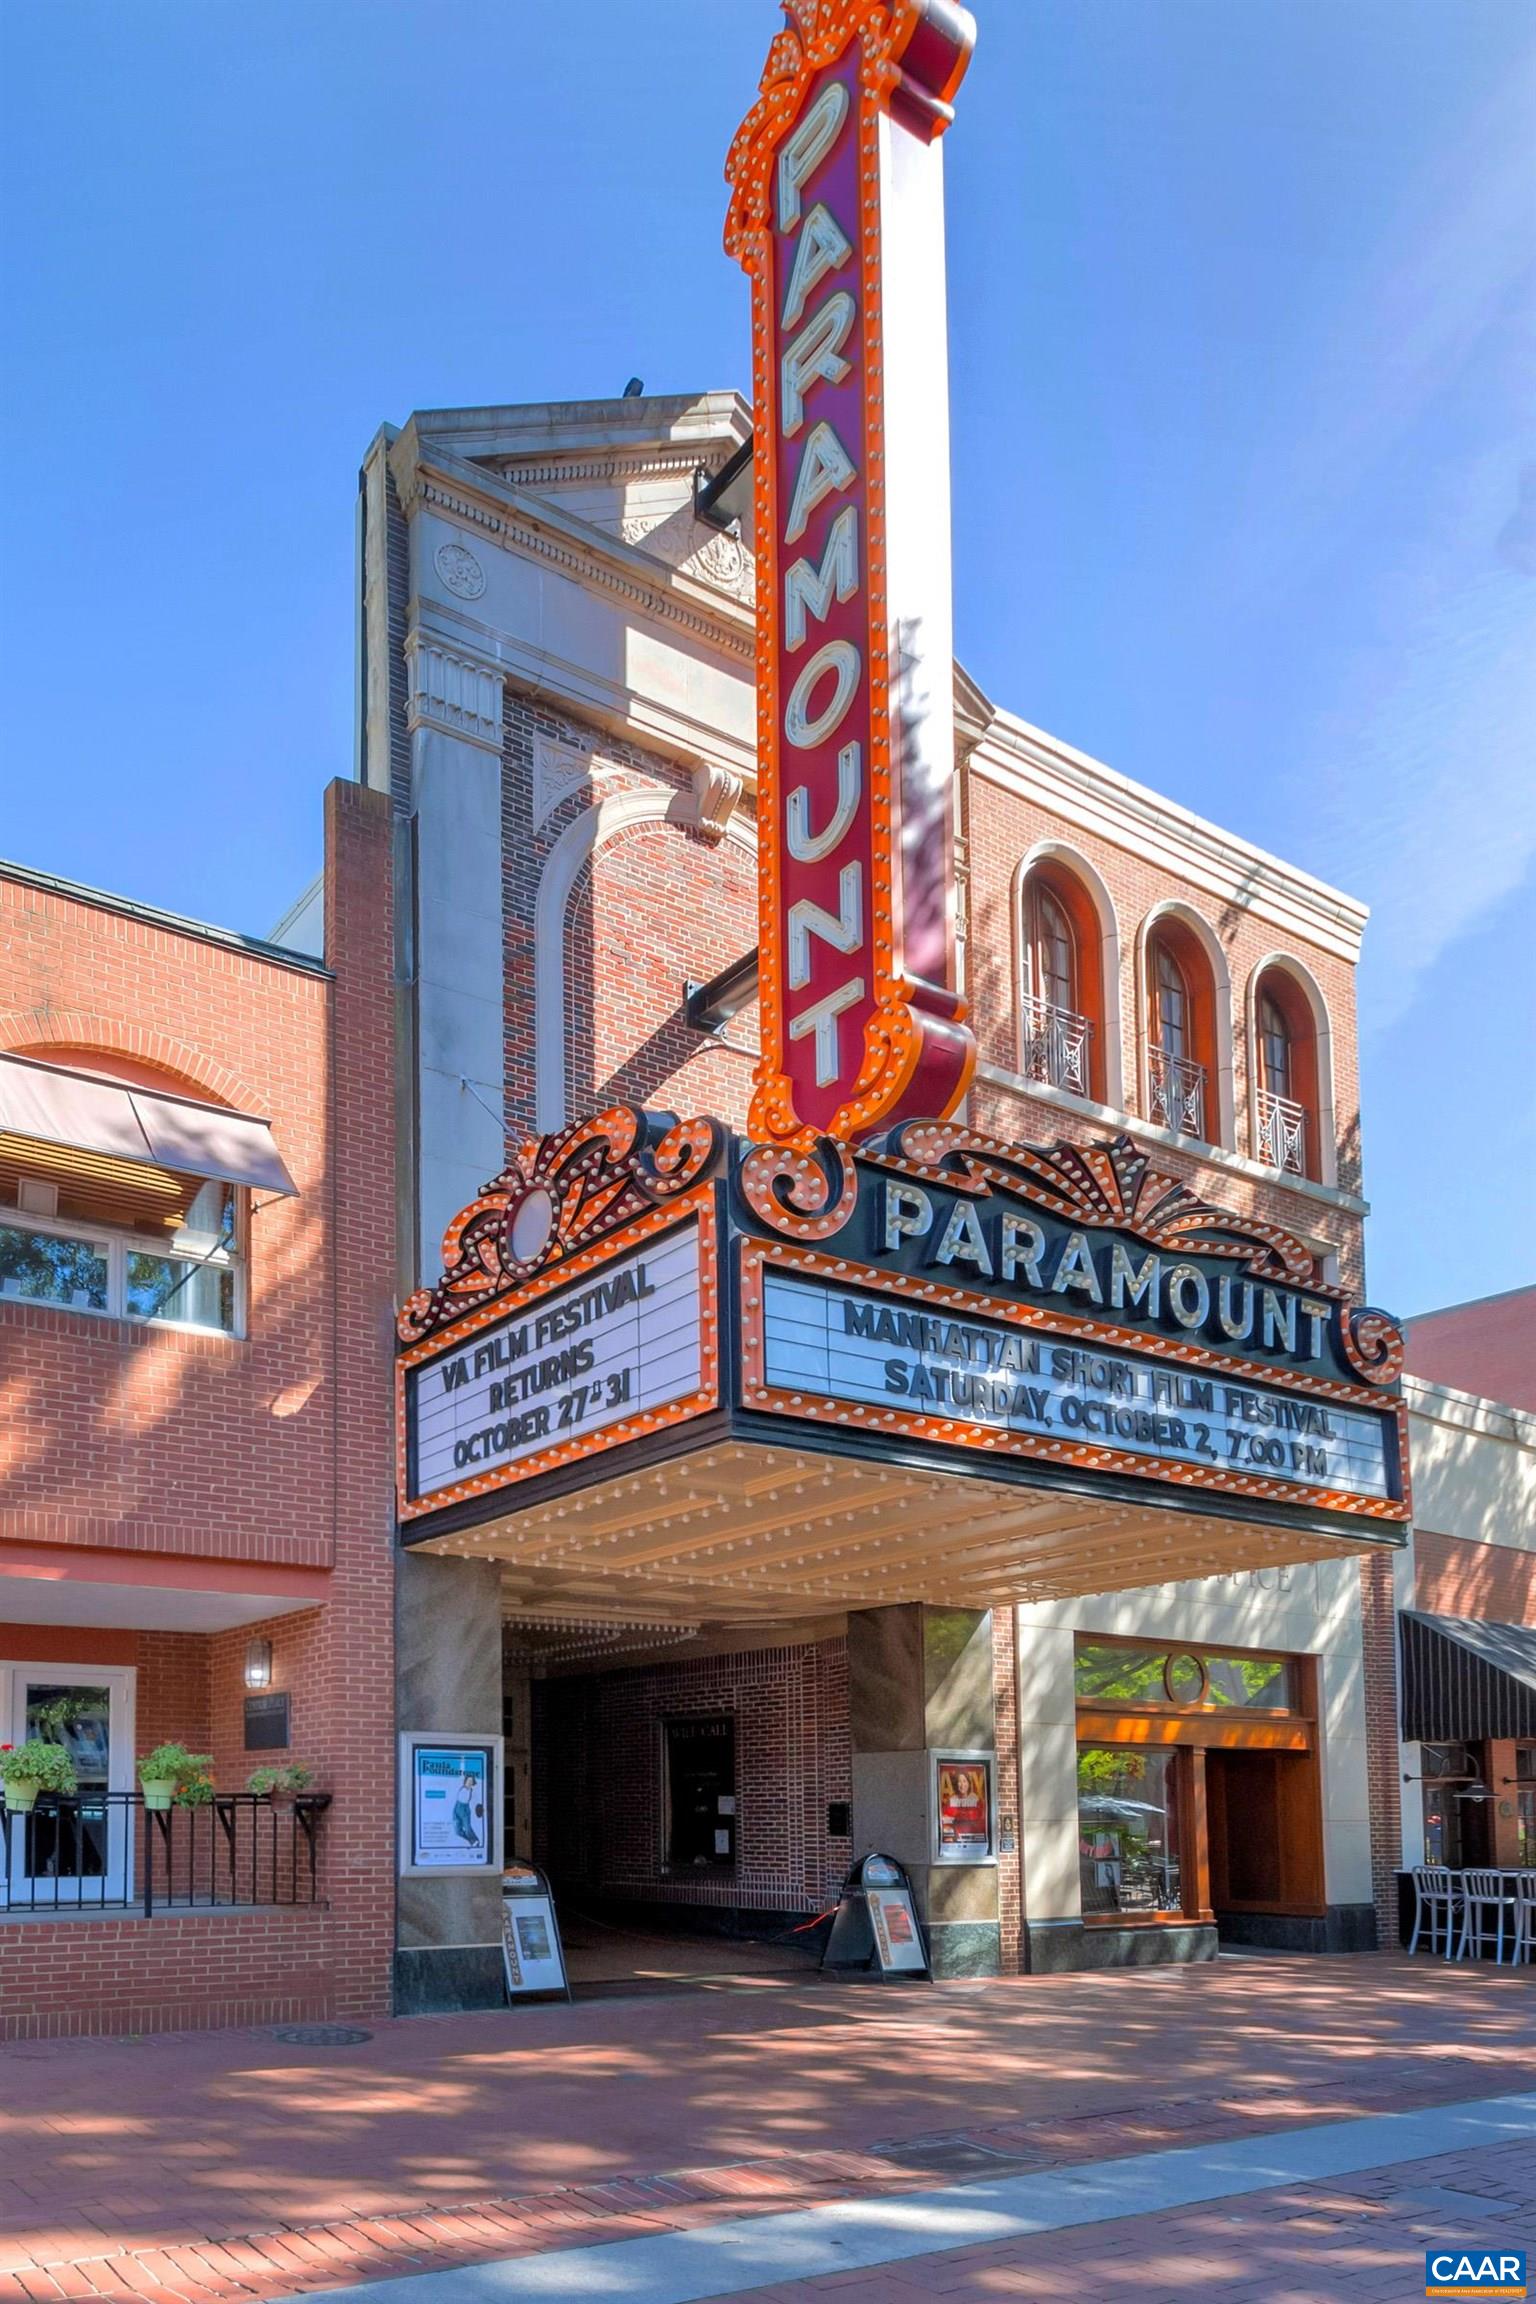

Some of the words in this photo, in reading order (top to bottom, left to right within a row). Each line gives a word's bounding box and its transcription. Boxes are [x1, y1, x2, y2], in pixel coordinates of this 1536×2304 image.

[777, 82, 864, 1087] PARAMOUNT
[441, 1357, 469, 1392] VA
[474, 1326, 528, 1379] FILM
[535, 1263, 655, 1349] FESTIVAL
[884, 1179, 1331, 1359] PARAMOUNT
[489, 1338, 594, 1414] RETURNS
[844, 1299, 1040, 1375] MANHATTAN
[1052, 1347, 1144, 1397] SHORT
[1151, 1370, 1214, 1412] FILM
[1224, 1387, 1336, 1440] FESTIVAL
[884, 1358, 1052, 1428] SATURDAY,
[1061, 1395, 1187, 1449] OCTOBER
[1291, 1441, 1328, 1477] PM
[453, 1406, 550, 1468] OCTOBER
